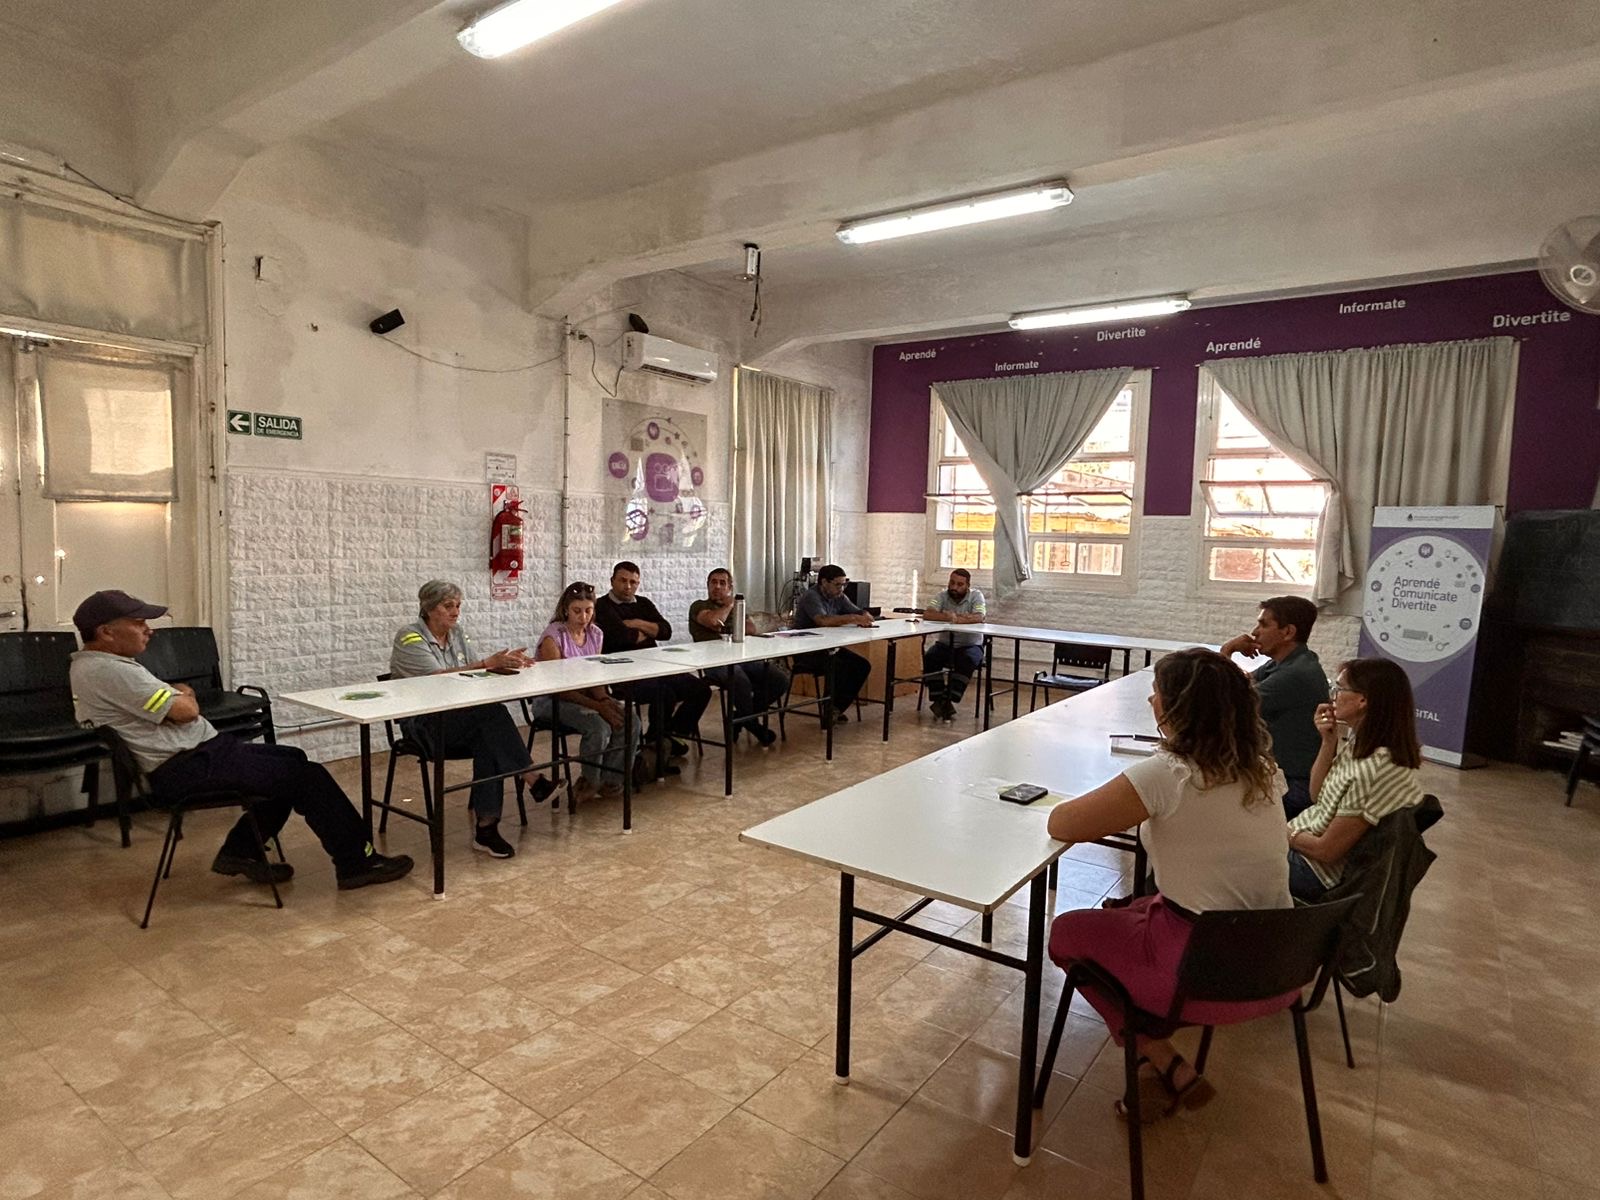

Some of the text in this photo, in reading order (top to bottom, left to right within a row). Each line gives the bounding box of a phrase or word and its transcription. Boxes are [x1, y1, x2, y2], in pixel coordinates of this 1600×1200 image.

[1339, 298, 1406, 314] Informate
[1492, 310, 1571, 329] Divertite
[1096, 326, 1147, 342] Divertite
[1205, 337, 1262, 354] Aprendé
[898, 348, 937, 362] Aprendé
[994, 360, 1040, 372] Informate
[258, 416, 298, 431] SALIDA
[1393, 576, 1441, 590] Aprendé
[1392, 586, 1458, 603] Comunicate
[1391, 597, 1437, 612] Divertite
